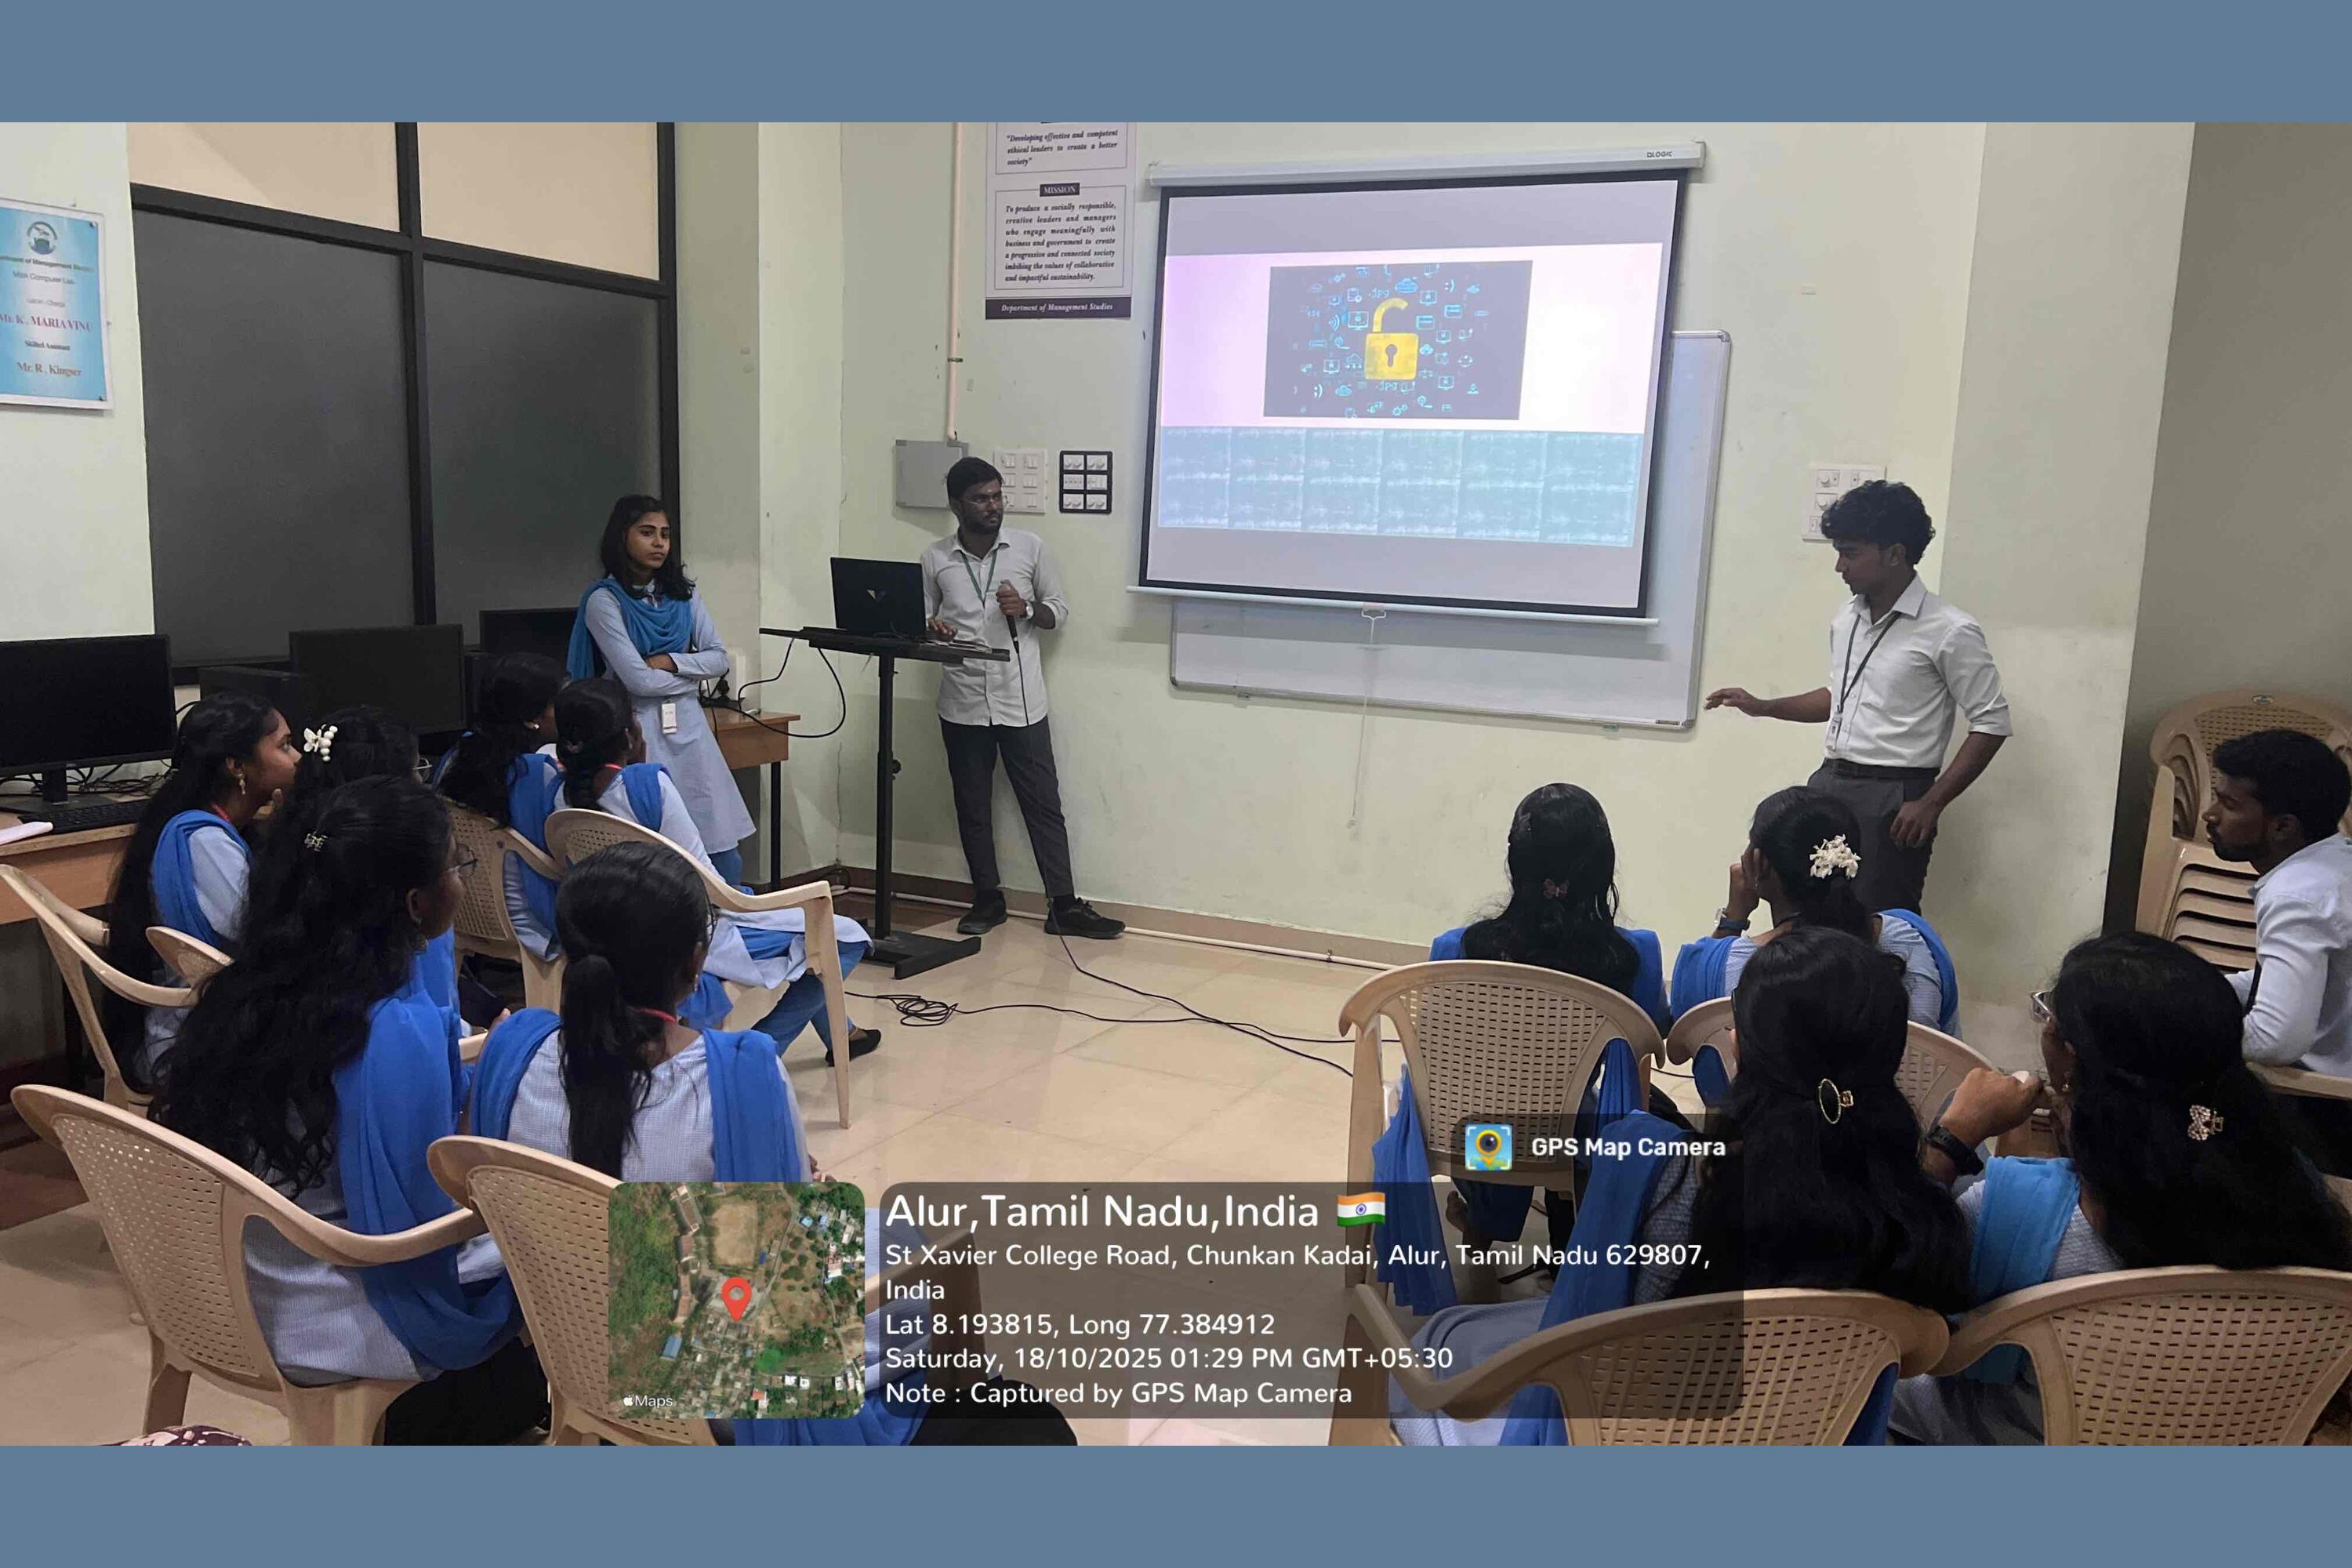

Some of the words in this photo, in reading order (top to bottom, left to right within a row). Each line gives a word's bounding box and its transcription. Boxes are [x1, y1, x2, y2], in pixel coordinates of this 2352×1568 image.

[1044, 132, 1069, 141] effective
[1087, 129, 1118, 138] competent
[1015, 205, 1040, 214] produce
[1051, 203, 1075, 212] socially
[1079, 202, 1116, 211] responsible,
[1006, 215, 1033, 223] creative
[1083, 215, 1116, 223] managers
[1047, 239, 1083, 248] government
[1018, 274, 1049, 282] impactful
[1051, 273, 1095, 281] sustainability.
[1047, 303, 1087, 312] Management
